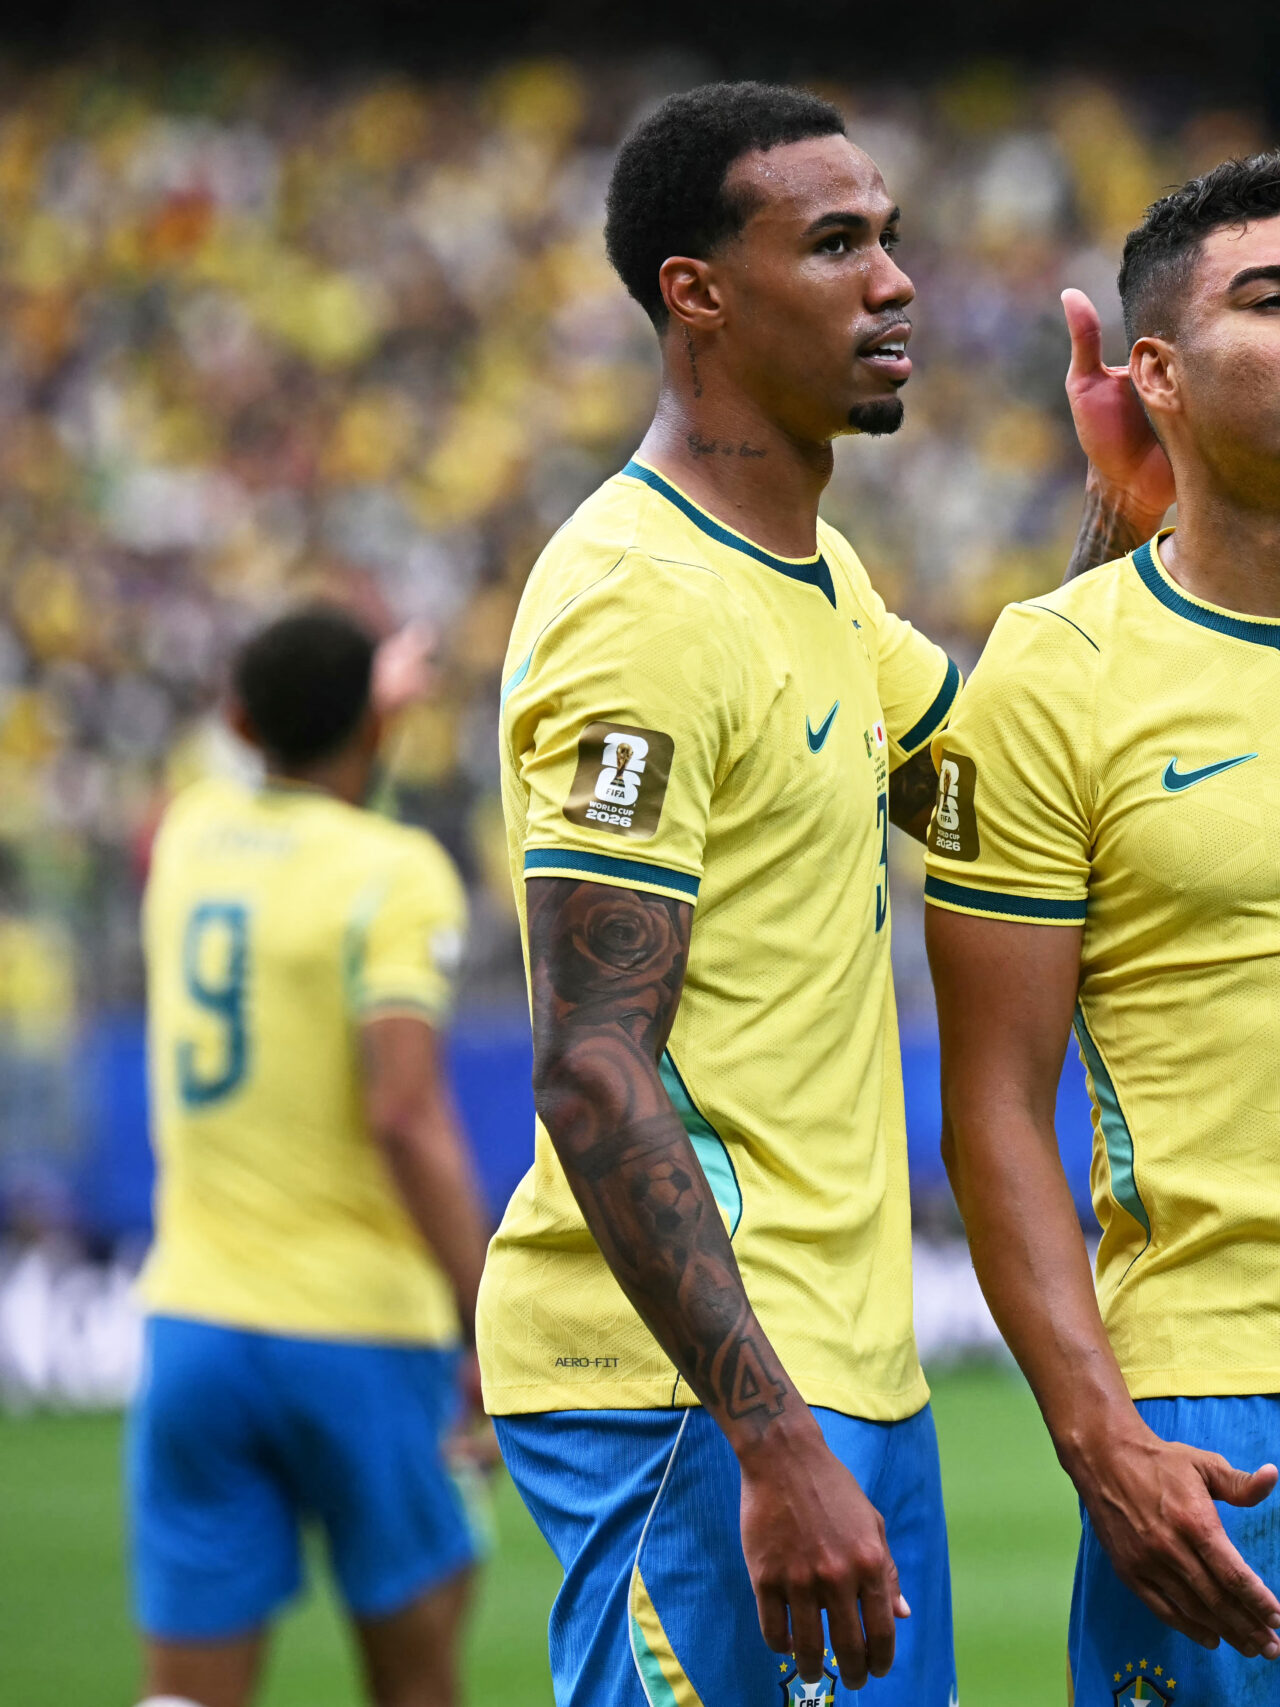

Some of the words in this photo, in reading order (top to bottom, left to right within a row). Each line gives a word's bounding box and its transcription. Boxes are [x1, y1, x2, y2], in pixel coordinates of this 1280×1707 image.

[606, 788, 625, 799] FIFA
[589, 800, 617, 813] WORLD
[618, 807, 634, 816] CUP
[585, 808, 632, 828] 2026
[940, 814, 952, 823] FIFA
[936, 836, 960, 851] 2026
[176, 901, 250, 1110] 9
[555, 1357, 620, 1367] AERO-FIT
[724, 1335, 788, 1420] 4
